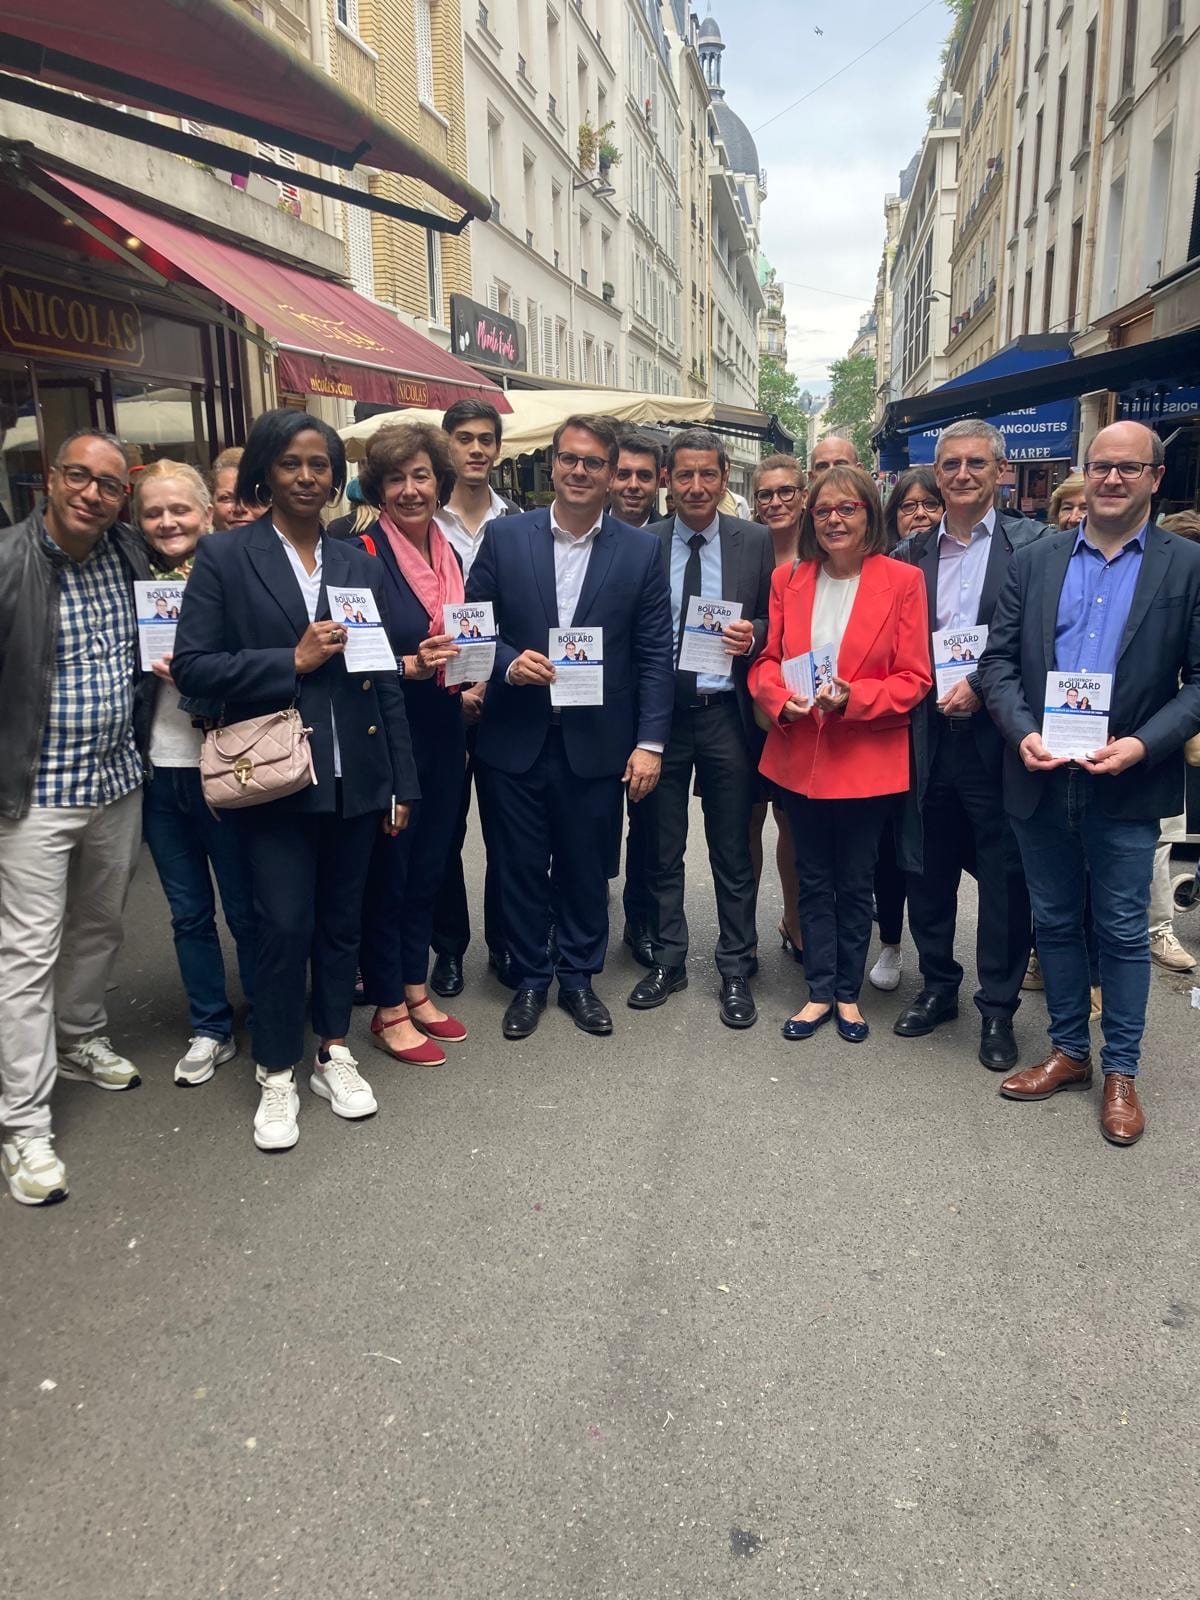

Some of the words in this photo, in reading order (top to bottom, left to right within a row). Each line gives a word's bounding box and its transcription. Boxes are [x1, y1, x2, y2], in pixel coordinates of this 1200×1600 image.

[7, 284, 137, 352] NICOLAS
[309, 373, 354, 398] nicolas.com
[398, 381, 428, 403] NICOLAS
[999, 421, 1068, 435] ANGOUSTES
[334, 595, 367, 605] BOULARD
[452, 610, 485, 620] BOULARD
[697, 605, 732, 617] BOULARD
[558, 635, 594, 643] BOULARD
[943, 634, 979, 646] BOULARD
[1058, 680, 1101, 690] BOULARD
